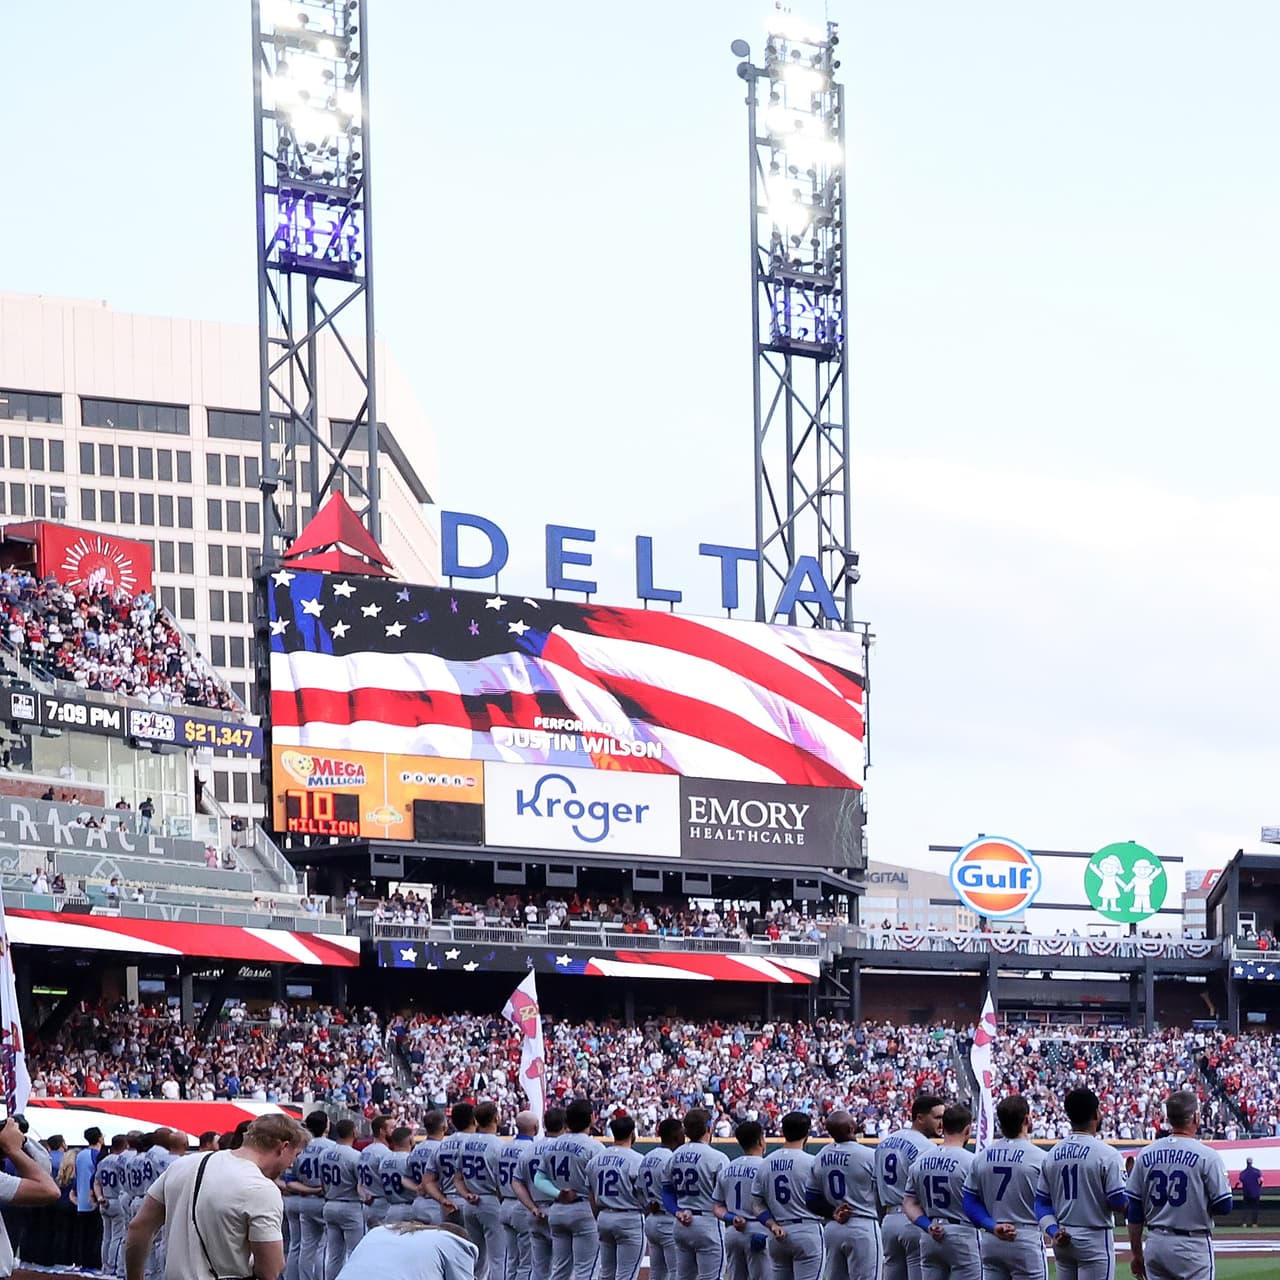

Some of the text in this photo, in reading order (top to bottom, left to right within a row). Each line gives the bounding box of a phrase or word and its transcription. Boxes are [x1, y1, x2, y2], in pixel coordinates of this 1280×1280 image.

[442, 510, 840, 624] DELTA
[46, 700, 87, 724] 7:09
[90, 707, 120, 729] PM
[185, 720, 253, 748] $21,347
[505, 731, 663, 758] JUSTIN WILSON
[312, 757, 364, 777] MEGA
[288, 791, 334, 820] 70
[516, 774, 649, 843] Kroger
[688, 796, 809, 831] EMORY
[289, 818, 359, 836] MILLION
[690, 827, 805, 845] HEALTHCARE
[865, 871, 908, 884] IGITAL
[957, 865, 1032, 889] Gulf
[674, 1152, 702, 1165] ENSEN
[770, 1159, 793, 1172] INDIA
[821, 1153, 850, 1167] MARTE
[920, 1158, 959, 1173] THOMAS
[987, 1149, 1008, 1163] WITT
[1054, 1145, 1089, 1161] GARCIA
[1142, 1151, 1200, 1169] QUATRARO
[300, 1158, 319, 1179] 41
[321, 1164, 341, 1186] 60
[462, 1156, 487, 1180] 52
[550, 1156, 570, 1182] 14
[884, 1153, 897, 1185] 9
[598, 1169, 619, 1196] 12
[671, 1168, 700, 1196] 22
[734, 1181, 742, 1210] 1
[774, 1174, 791, 1205] 6
[828, 1169, 846, 1200] 0
[923, 1175, 949, 1209] 15
[993, 1166, 1012, 1200] 7
[1061, 1164, 1079, 1200] 11
[1148, 1169, 1188, 1208] 33
